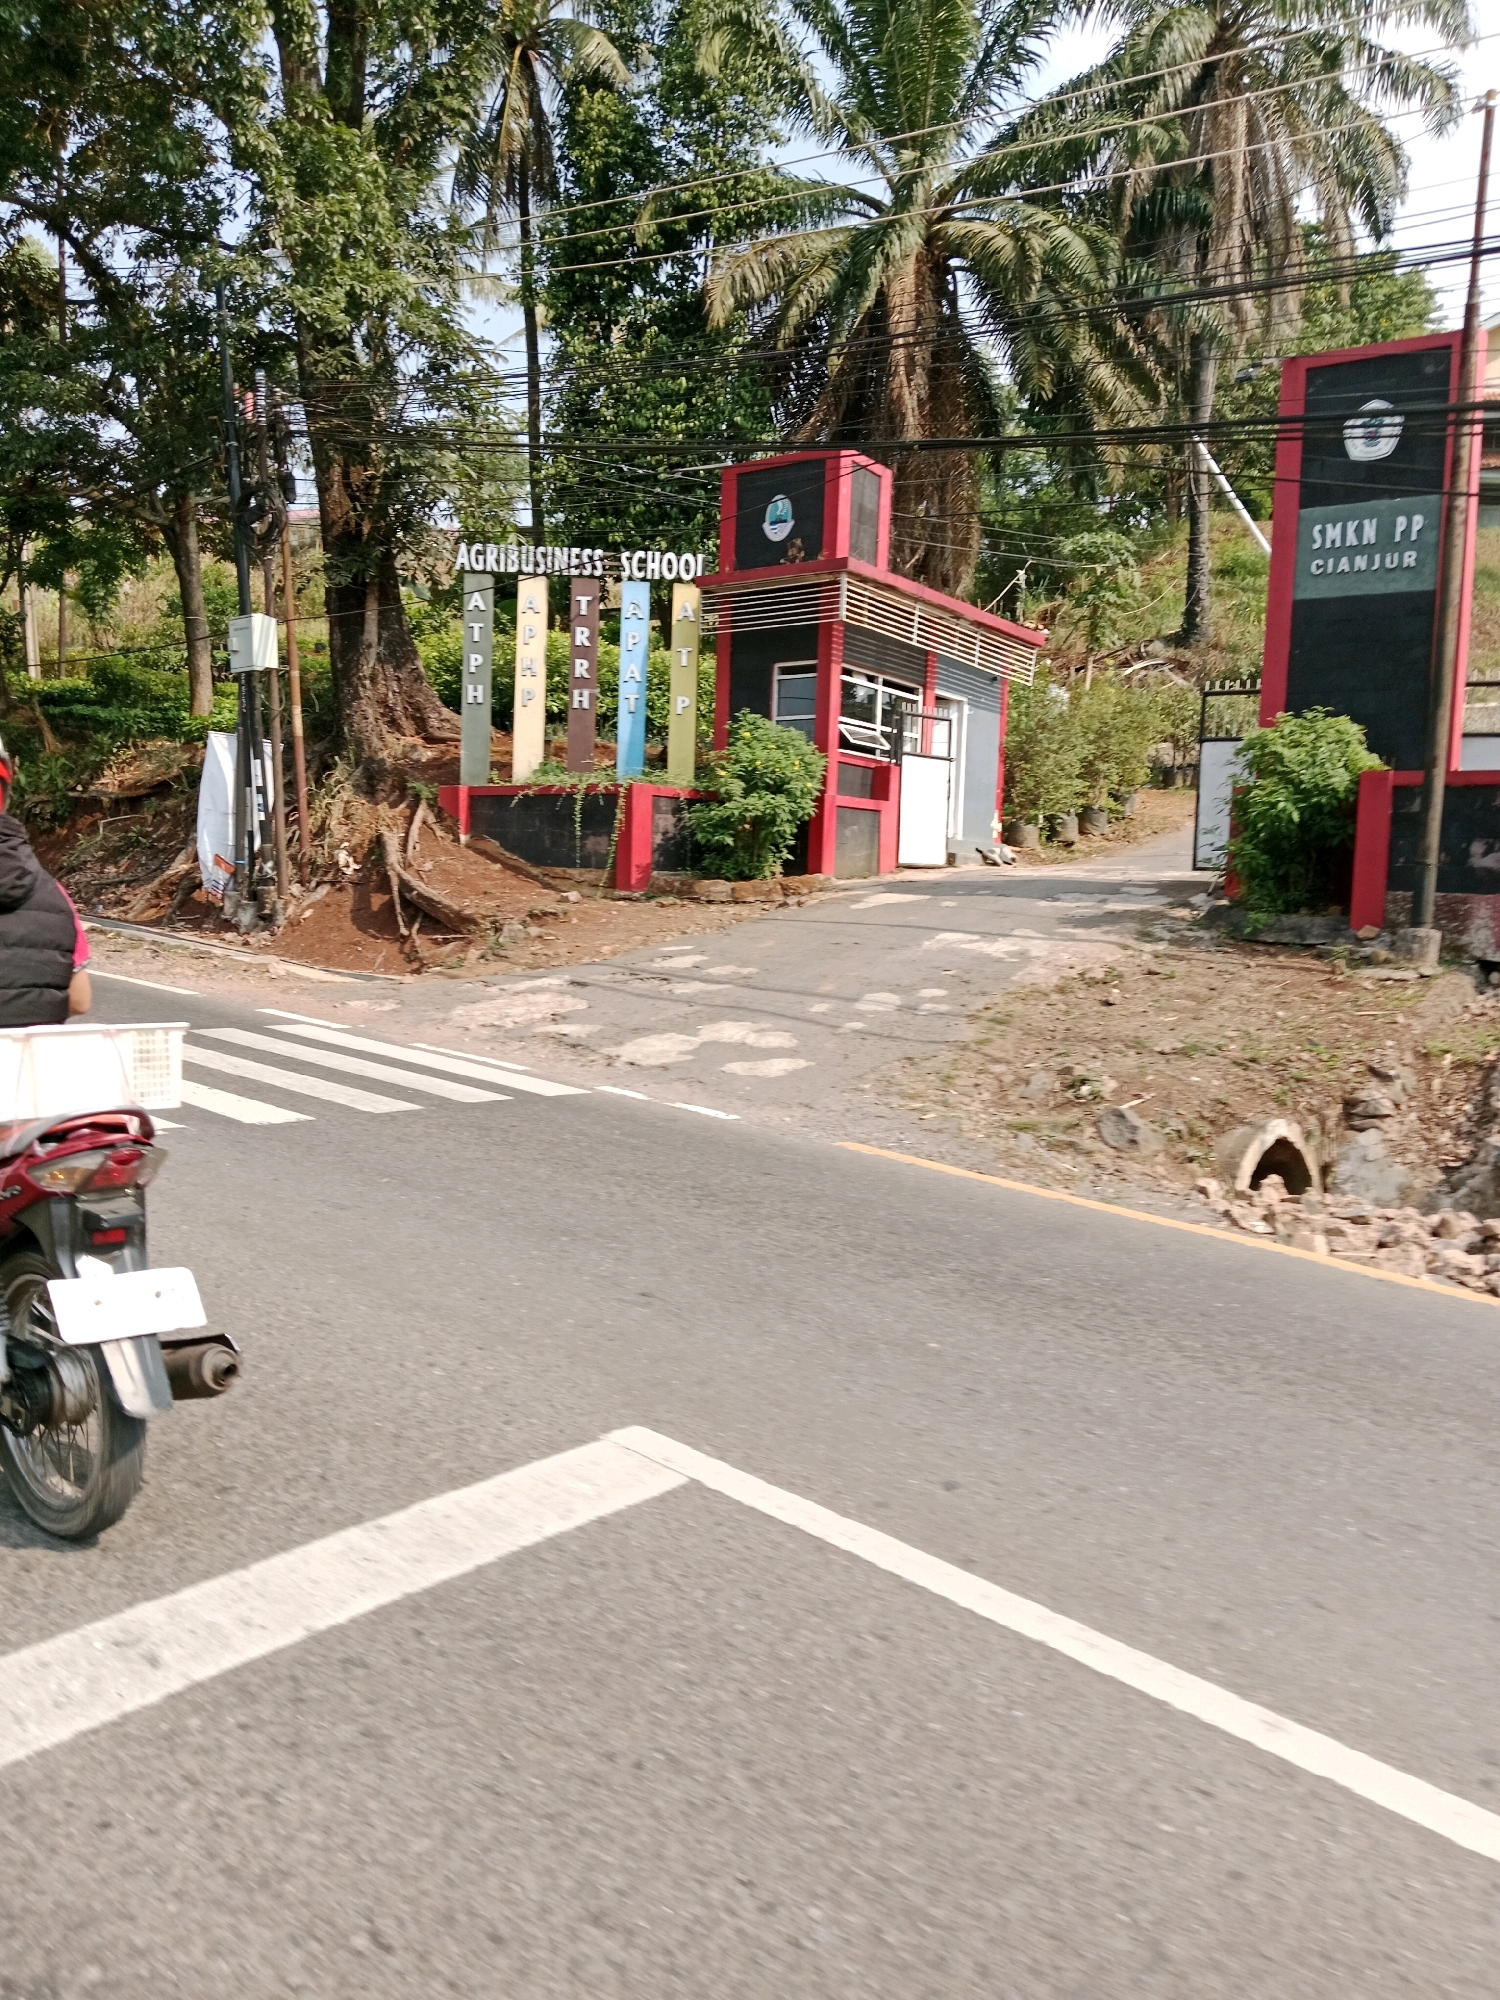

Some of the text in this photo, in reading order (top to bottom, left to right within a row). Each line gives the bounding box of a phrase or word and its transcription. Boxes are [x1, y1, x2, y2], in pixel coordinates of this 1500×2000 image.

[455, 542, 604, 576] AGRIBUSINESS
[1310, 550, 1418, 576] CIANJUR
[1311, 513, 1425, 550] SMKN PP
[465, 591, 487, 705] ATPH
[520, 595, 541, 707] APHP
[571, 595, 593, 711] TRRH
[623, 599, 644, 714] APAT
[675, 601, 696, 716] ATP
